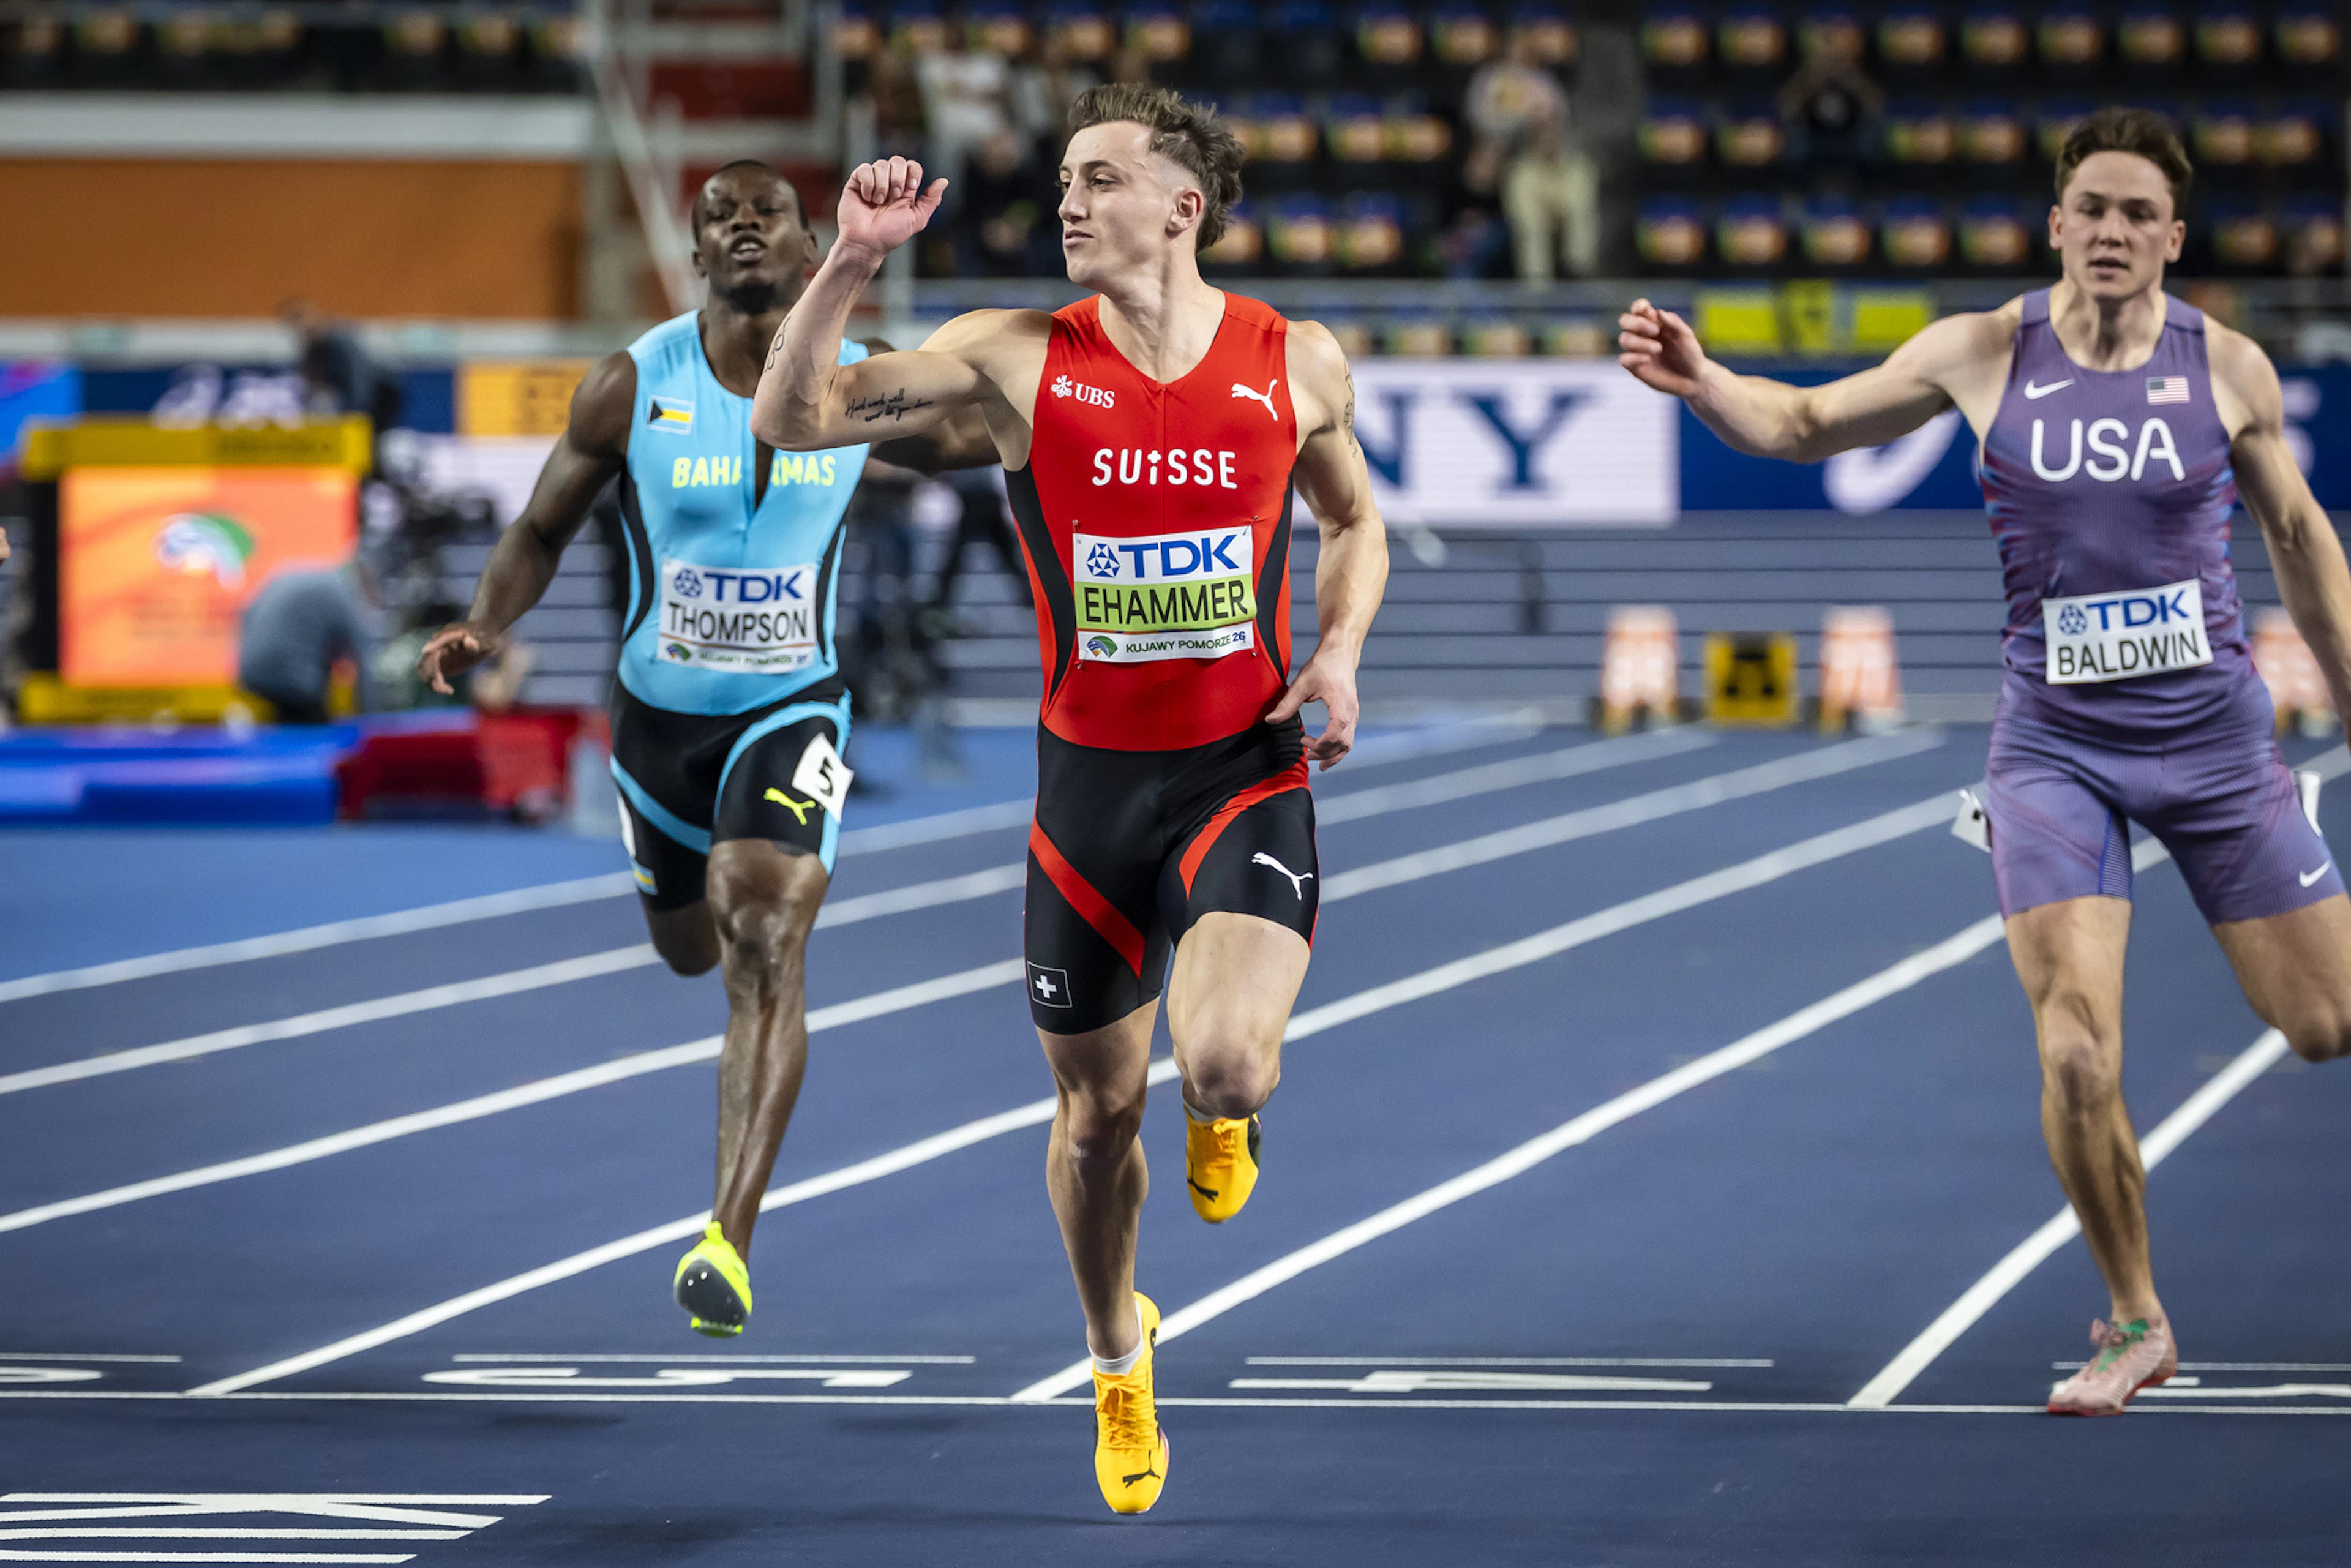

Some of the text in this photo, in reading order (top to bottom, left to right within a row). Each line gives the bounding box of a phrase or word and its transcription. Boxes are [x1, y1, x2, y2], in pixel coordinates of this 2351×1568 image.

[1075, 383, 1115, 408] UBS
[2030, 418, 2185, 482] USA
[1119, 535, 1239, 578] TDK
[704, 570, 803, 602] TDK
[1084, 580, 1248, 625] EHAMMER
[668, 601, 808, 643] THOMPSON
[2086, 590, 2189, 631] TDK
[1126, 631, 1246, 653] KUJAWY POMORZE 26
[2058, 628, 2200, 675] BALDWIN
[817, 756, 834, 797] 5
